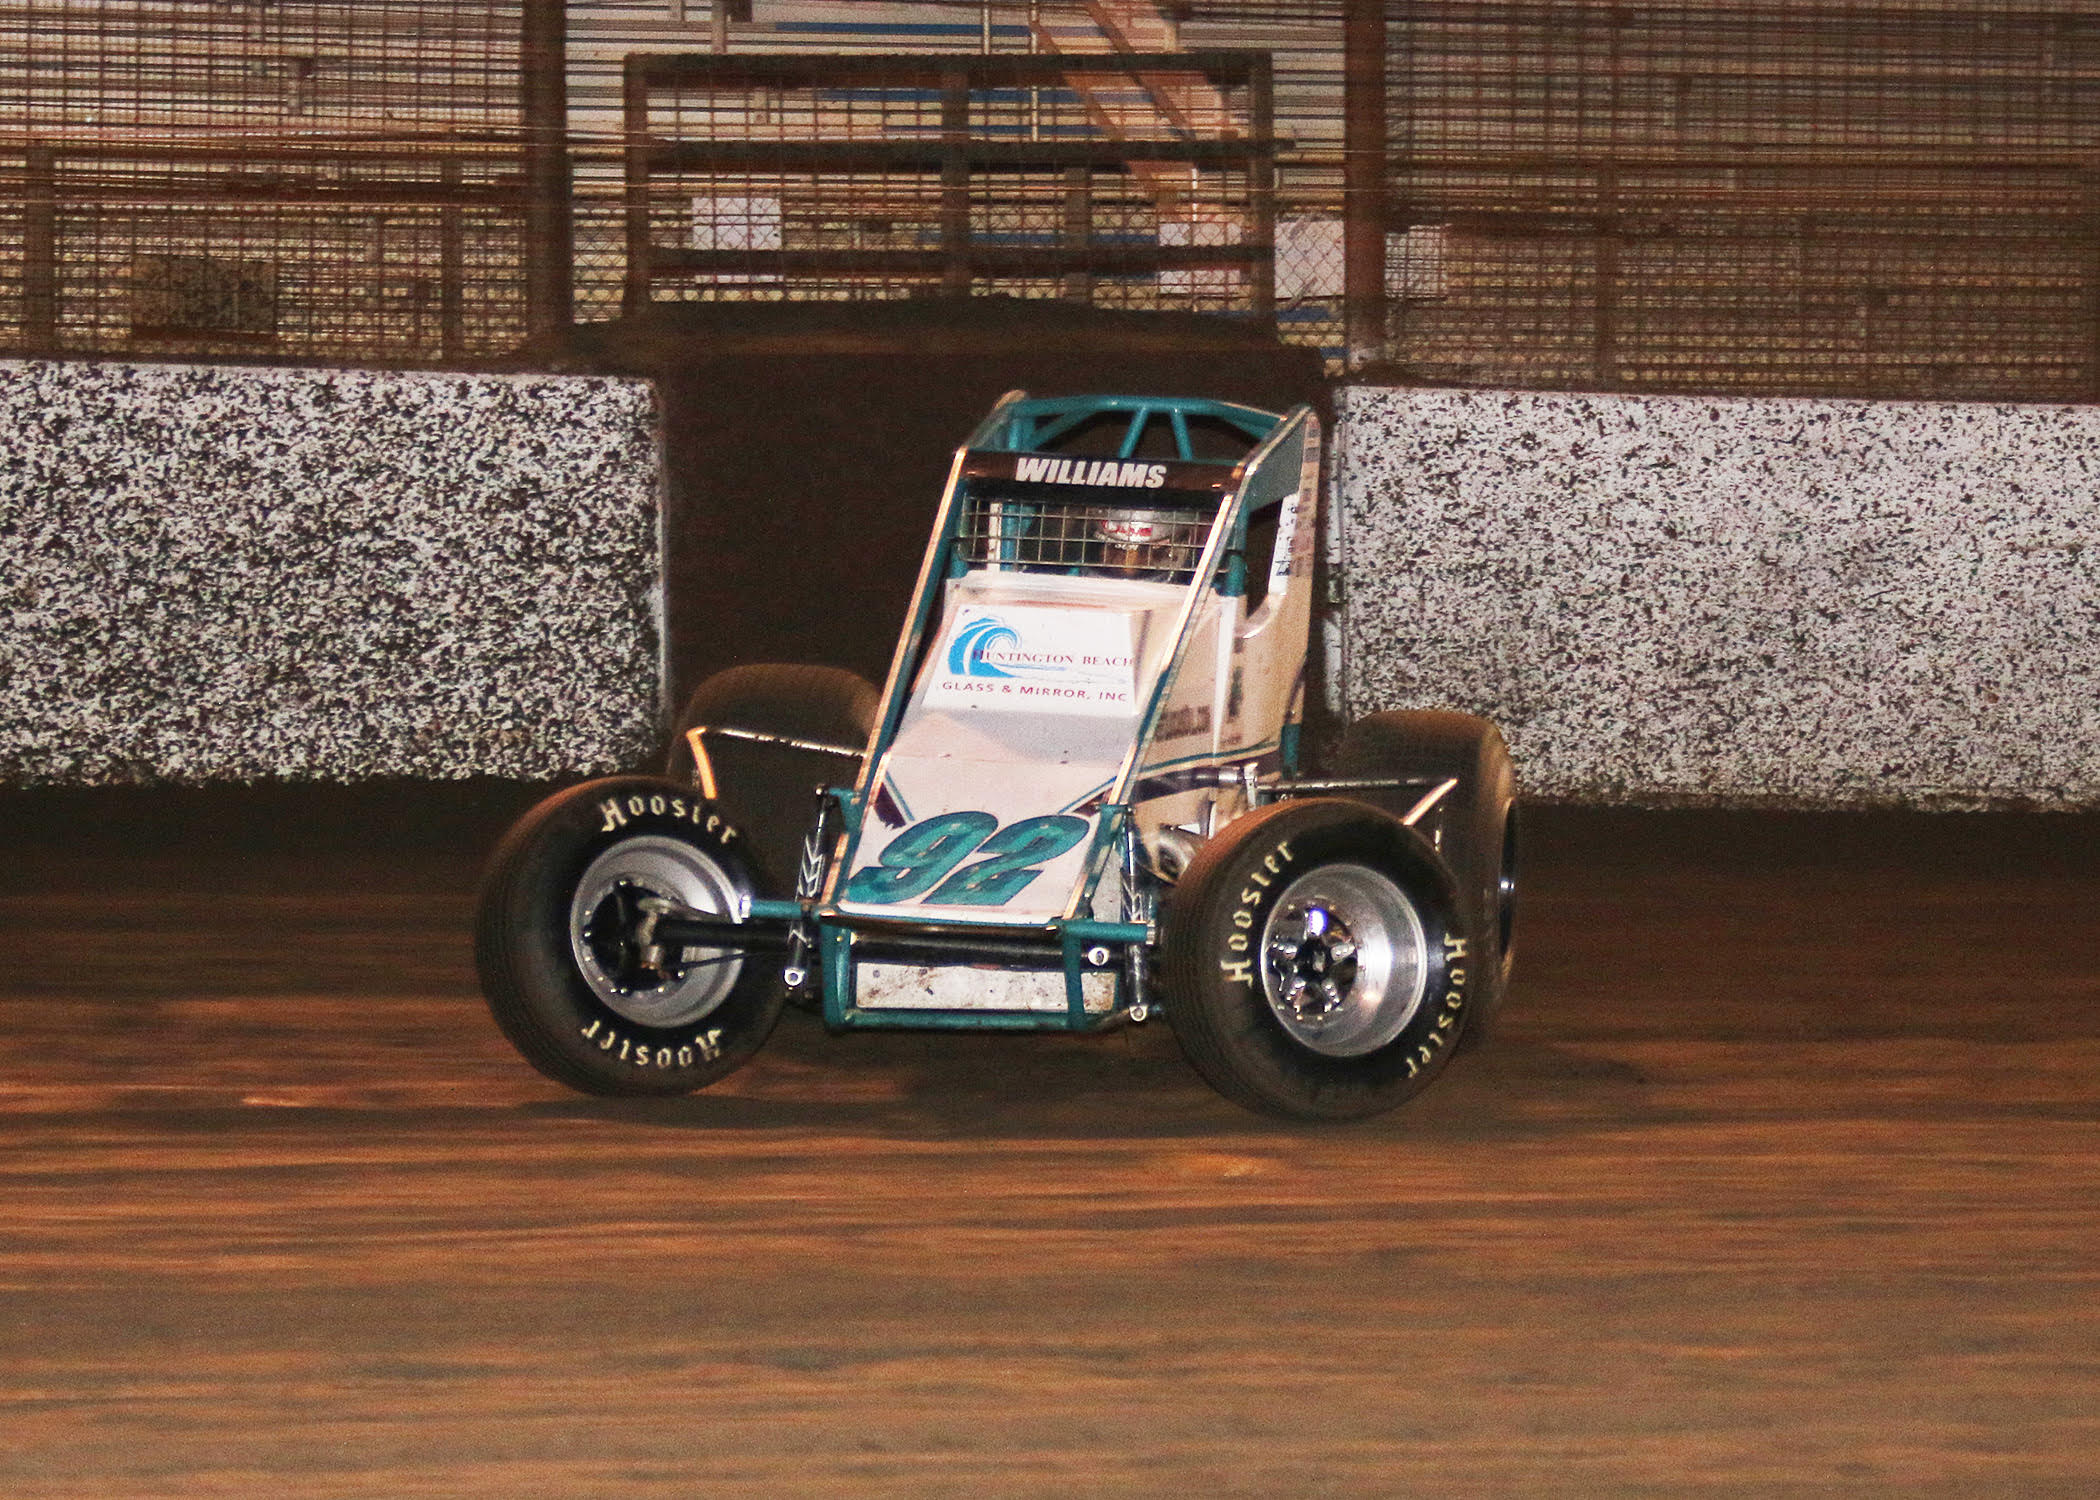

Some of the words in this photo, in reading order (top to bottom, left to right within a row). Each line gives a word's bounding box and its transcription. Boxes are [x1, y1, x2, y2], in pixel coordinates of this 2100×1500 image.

[1015, 457, 1167, 488] WILLIAMS
[972, 649, 1073, 664] HUNTINGTON
[942, 681, 994, 692] GLASS
[1001, 684, 1012, 694] &
[1019, 686, 1091, 700] MIRROR,
[1099, 691, 1128, 702] INC
[842, 810, 1090, 906] 92
